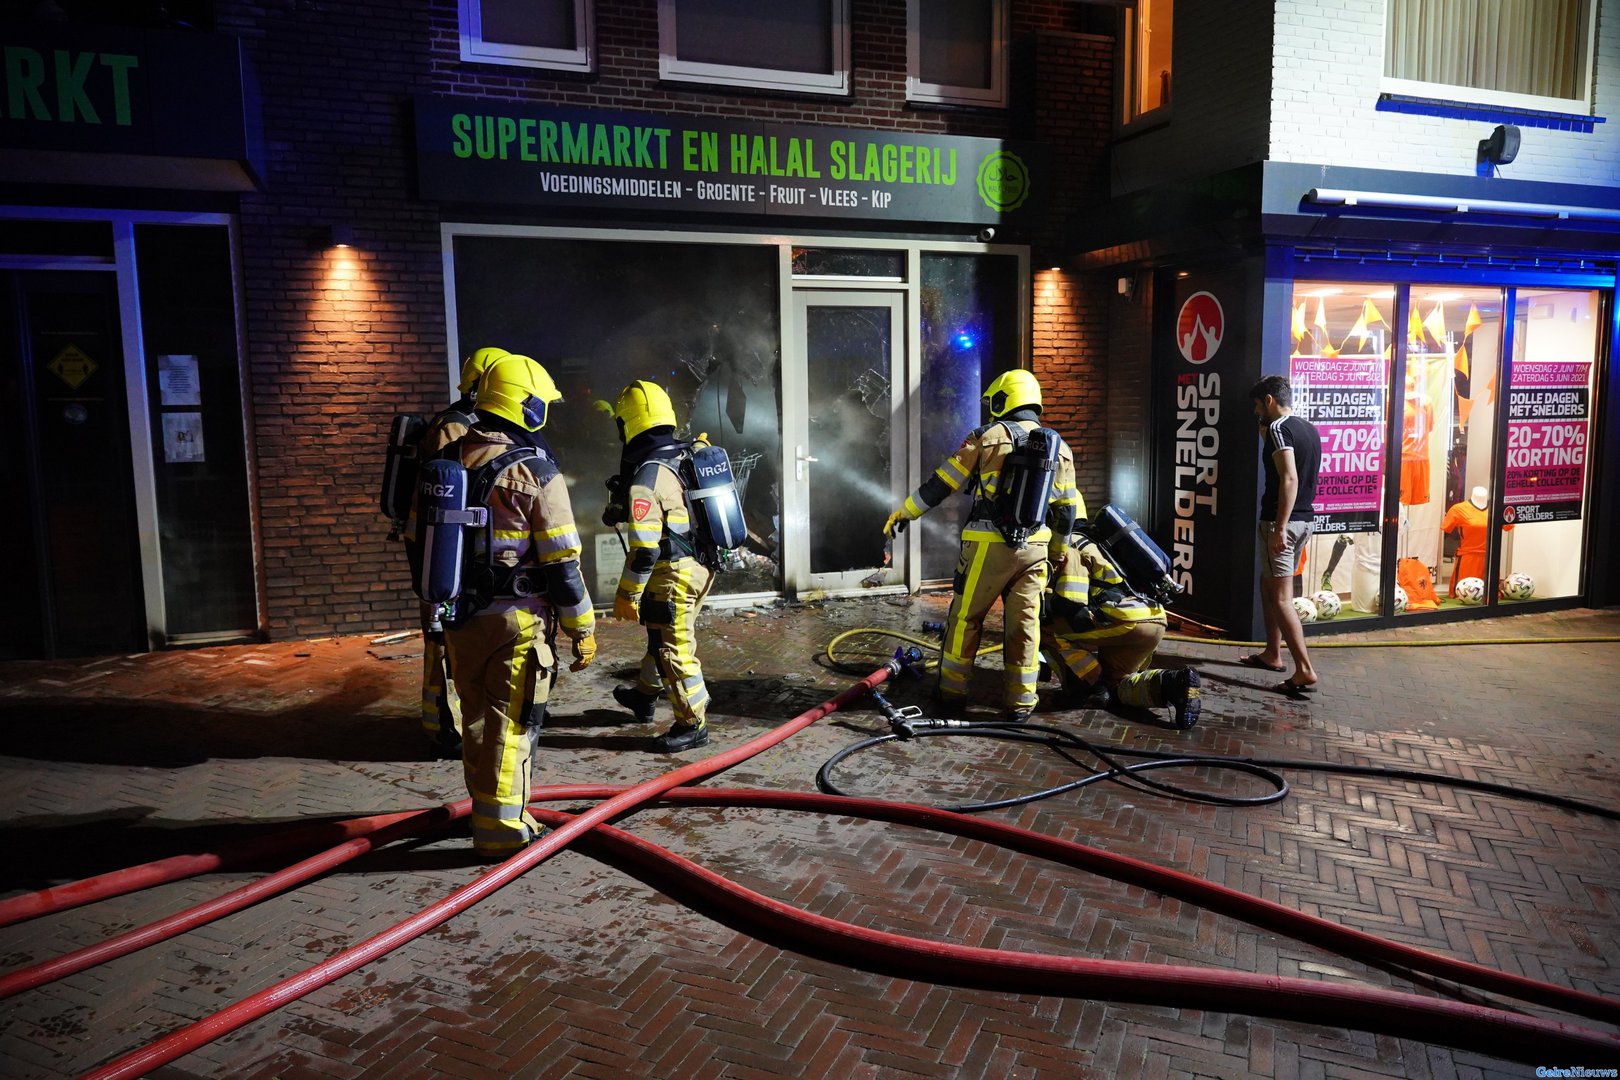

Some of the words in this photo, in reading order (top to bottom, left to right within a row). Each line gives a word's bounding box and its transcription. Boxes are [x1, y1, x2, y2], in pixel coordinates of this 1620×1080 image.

[0, 46, 138, 126] RKT
[452, 113, 671, 169] SUPERMARKT
[682, 130, 719, 173] EN
[730, 133, 821, 179] HALAL
[830, 140, 957, 186] SLAGERIJ
[540, 171, 681, 199] VOEDINGSMIDDELEN
[697, 180, 755, 202] GROENTE
[770, 184, 806, 205] FRUIT
[819, 187, 858, 208] VLEES
[1294, 361, 1342, 371] WOENSDAG
[1343, 362, 1349, 371] 2
[1350, 362, 1369, 372] JUNI
[1513, 364, 1552, 373] WOENSDAG
[1553, 365, 1558, 373] 2
[1559, 364, 1574, 373] JUNI
[1576, 364, 1589, 373] T/M
[1177, 372, 1199, 385] MET
[1294, 372, 1338, 381] ZATERDAG
[1339, 372, 1345, 381] 5
[1346, 372, 1365, 381] JUNI
[1512, 374, 1549, 382] ZATERDAG
[1550, 374, 1554, 382] 5
[1555, 374, 1570, 382] JUNI
[1570, 374, 1586, 382] 2021
[1293, 392, 1331, 405] DOLLE
[1333, 392, 1376, 405] DAGEN
[1510, 393, 1543, 404] DOLLE
[1545, 392, 1579, 404] DAGEN
[1292, 405, 1317, 418] MET
[1318, 405, 1381, 418] SNELDERS
[1509, 405, 1532, 417] MET
[1532, 404, 1585, 417] SNELDERS
[1320, 428, 1381, 451] -70%
[1508, 425, 1585, 448] 20-70%
[1196, 372, 1221, 516] SPORT
[1319, 452, 1380, 473] RTING
[1507, 446, 1584, 468] KORTING
[699, 461, 729, 479] VRGZ
[1524, 469, 1557, 478] KORTING
[1558, 468, 1569, 476] OP
[1571, 468, 1580, 476] DE
[1317, 476, 1351, 486] ORTING
[1351, 475, 1364, 484] OP
[1365, 475, 1378, 484] DE
[1506, 480, 1534, 488] GEHELE
[1173, 385, 1199, 596] SNELDERS
[1516, 505, 1540, 515] SPORT
[1313, 515, 1331, 524] ORT
[1518, 512, 1554, 522] SNELDERS
[1312, 522, 1347, 532] ELDERS
